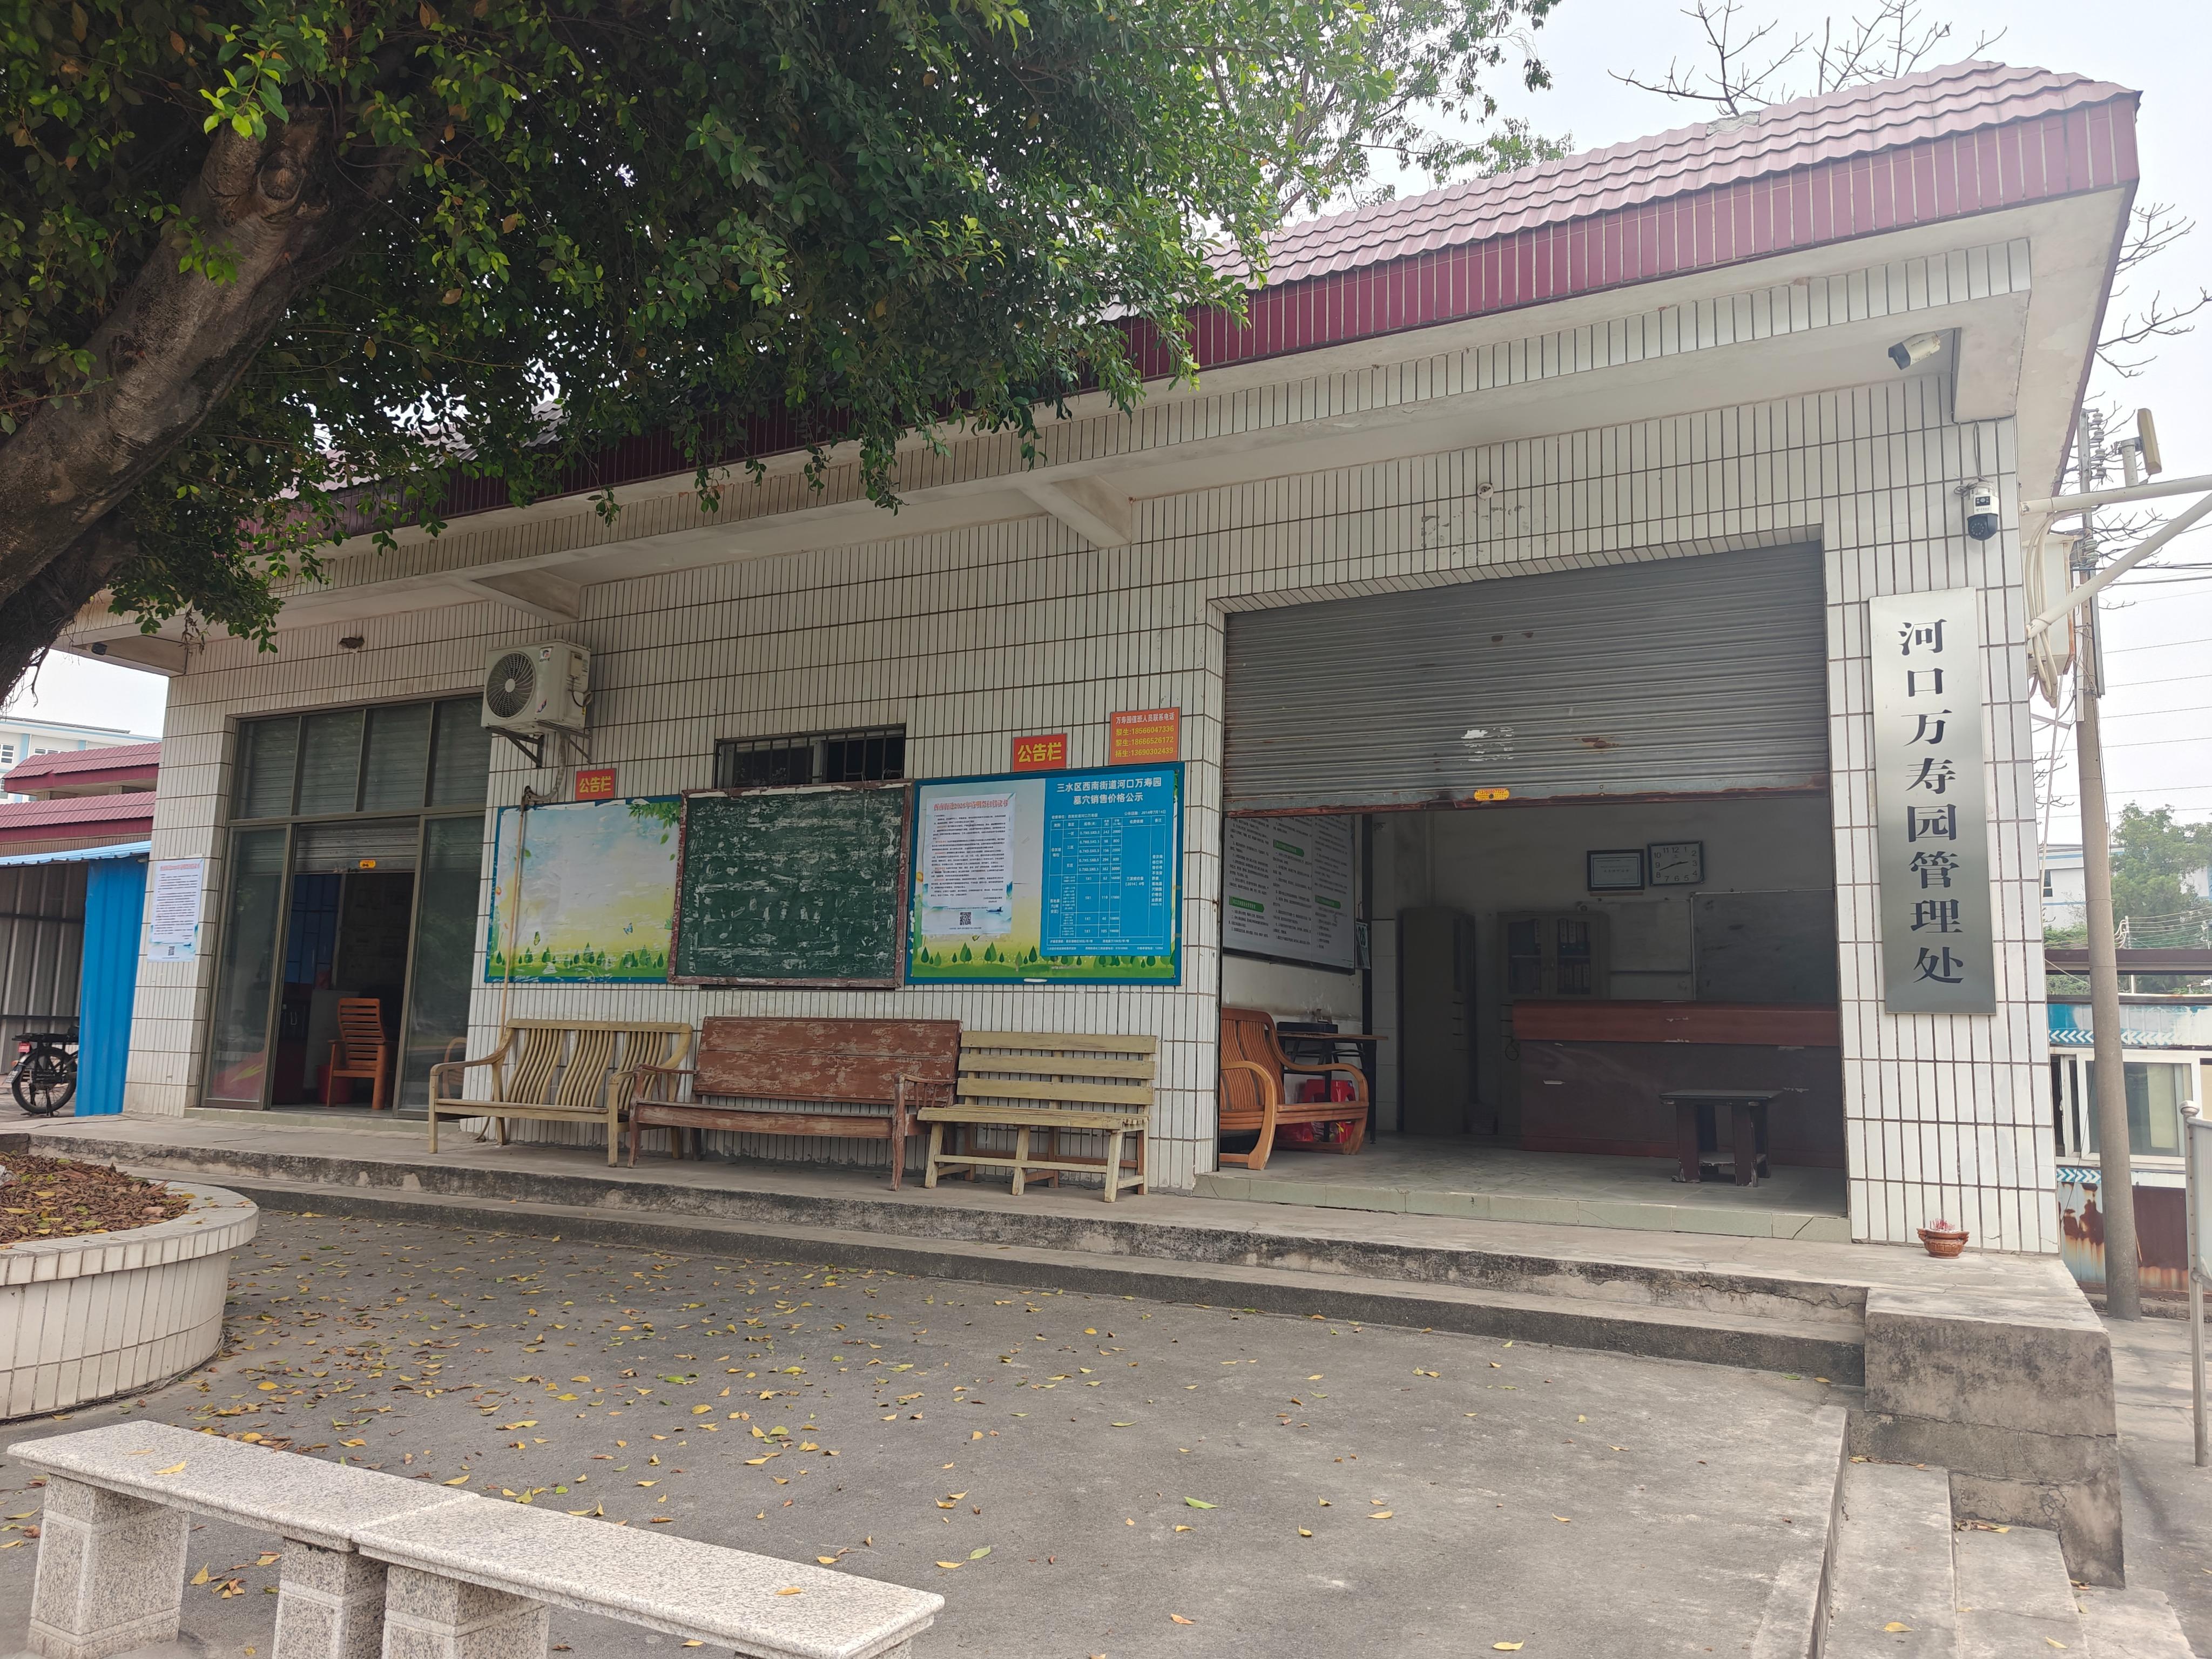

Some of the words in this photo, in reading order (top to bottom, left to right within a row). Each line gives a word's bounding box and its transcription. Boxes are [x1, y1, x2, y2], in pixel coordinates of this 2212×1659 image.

[1116, 712, 1175, 724] 万寿园值班人员联系电话
[1116, 725, 1174, 736] 黎生:18566047336
[1115, 736, 1174, 747] 黎生:18666526172
[1017, 741, 1062, 763] 公告栏
[1115, 747, 1174, 758] 杨生:13690302439
[579, 775, 612, 793] 公告栏
[1056, 777, 1162, 793] 三水区西南街道河口万寿园
[1073, 792, 1143, 805] 墓穴销售价格公示
[1898, 618, 1964, 984] 河口万寿园管理处
